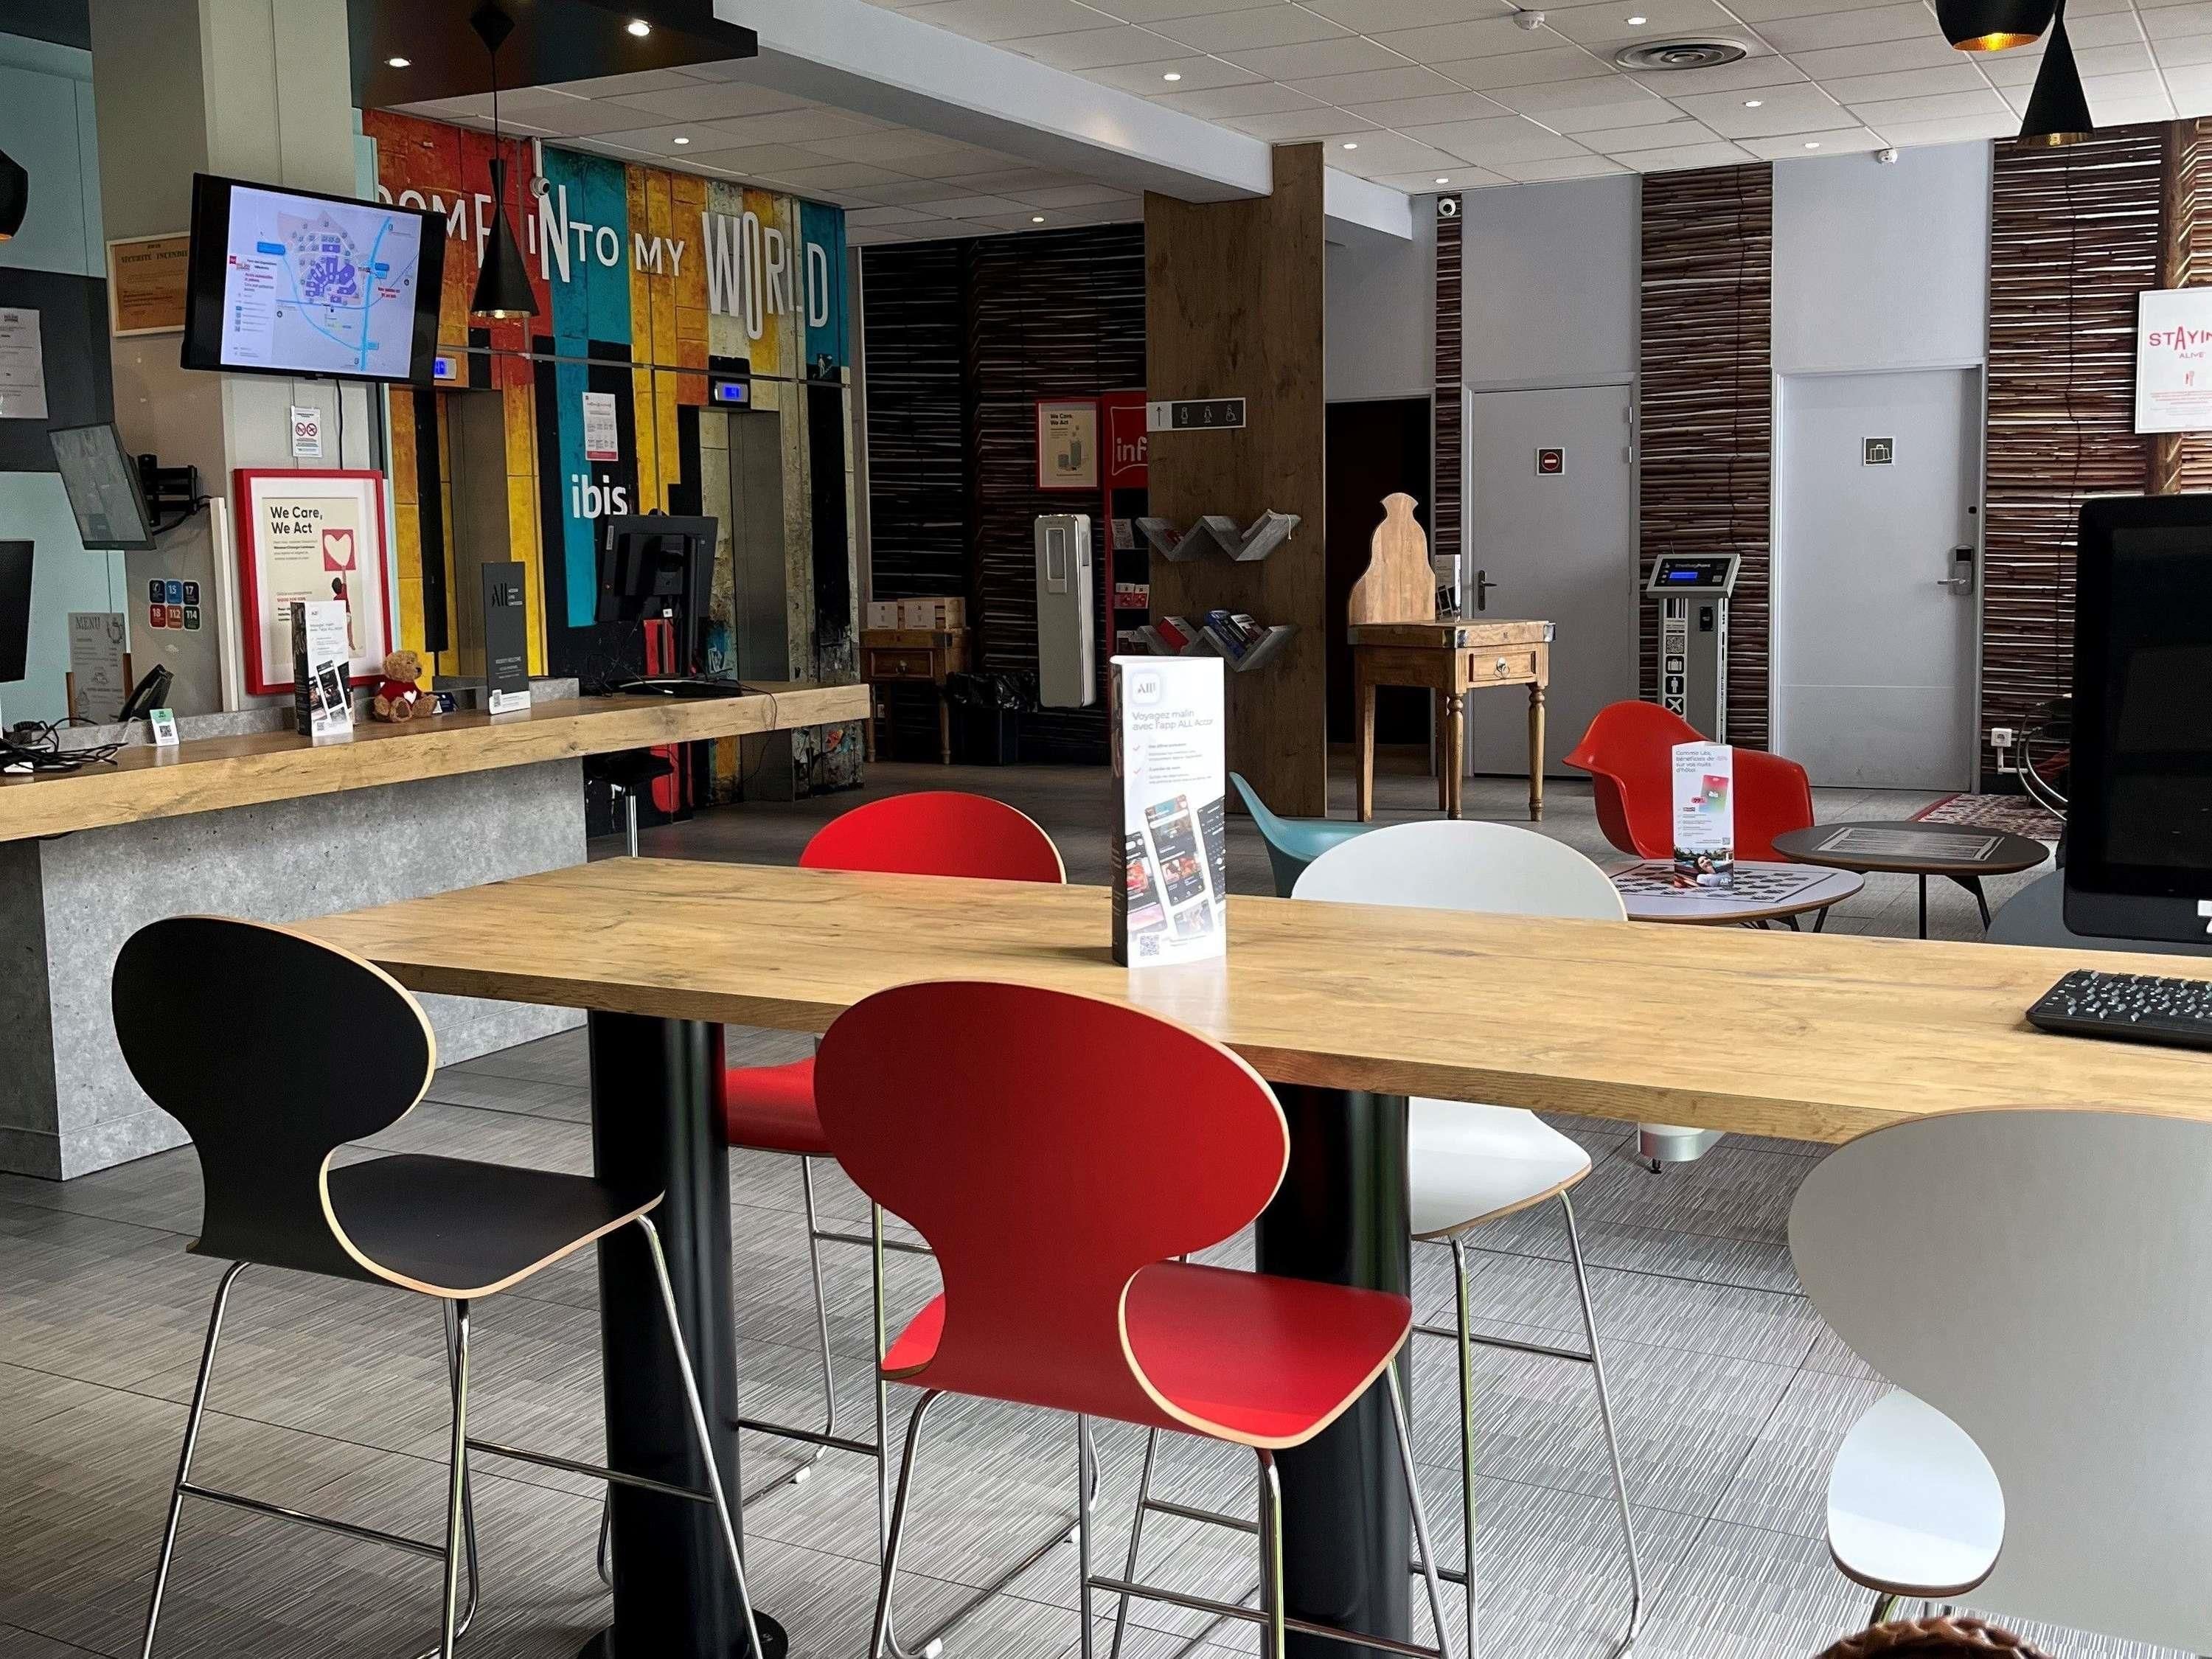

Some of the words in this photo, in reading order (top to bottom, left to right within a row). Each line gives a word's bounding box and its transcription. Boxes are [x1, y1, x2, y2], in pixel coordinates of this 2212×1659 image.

[635, 232, 685, 277] MY
[702, 211, 829, 340] WORLD
[571, 474, 627, 518] ibis
[271, 507, 289, 518] We
[292, 507, 323, 520] Care,
[271, 522, 291, 534] We
[294, 522, 313, 534] Act
[168, 585, 177, 594] 15
[185, 585, 194, 595] 17
[152, 608, 161, 617] 18
[169, 609, 181, 619] 112
[75, 616, 101, 630] MENU
[1132, 712, 1170, 721] Voyagez
[1171, 709, 1194, 718] malin
[1178, 720, 1193, 728] ALL
